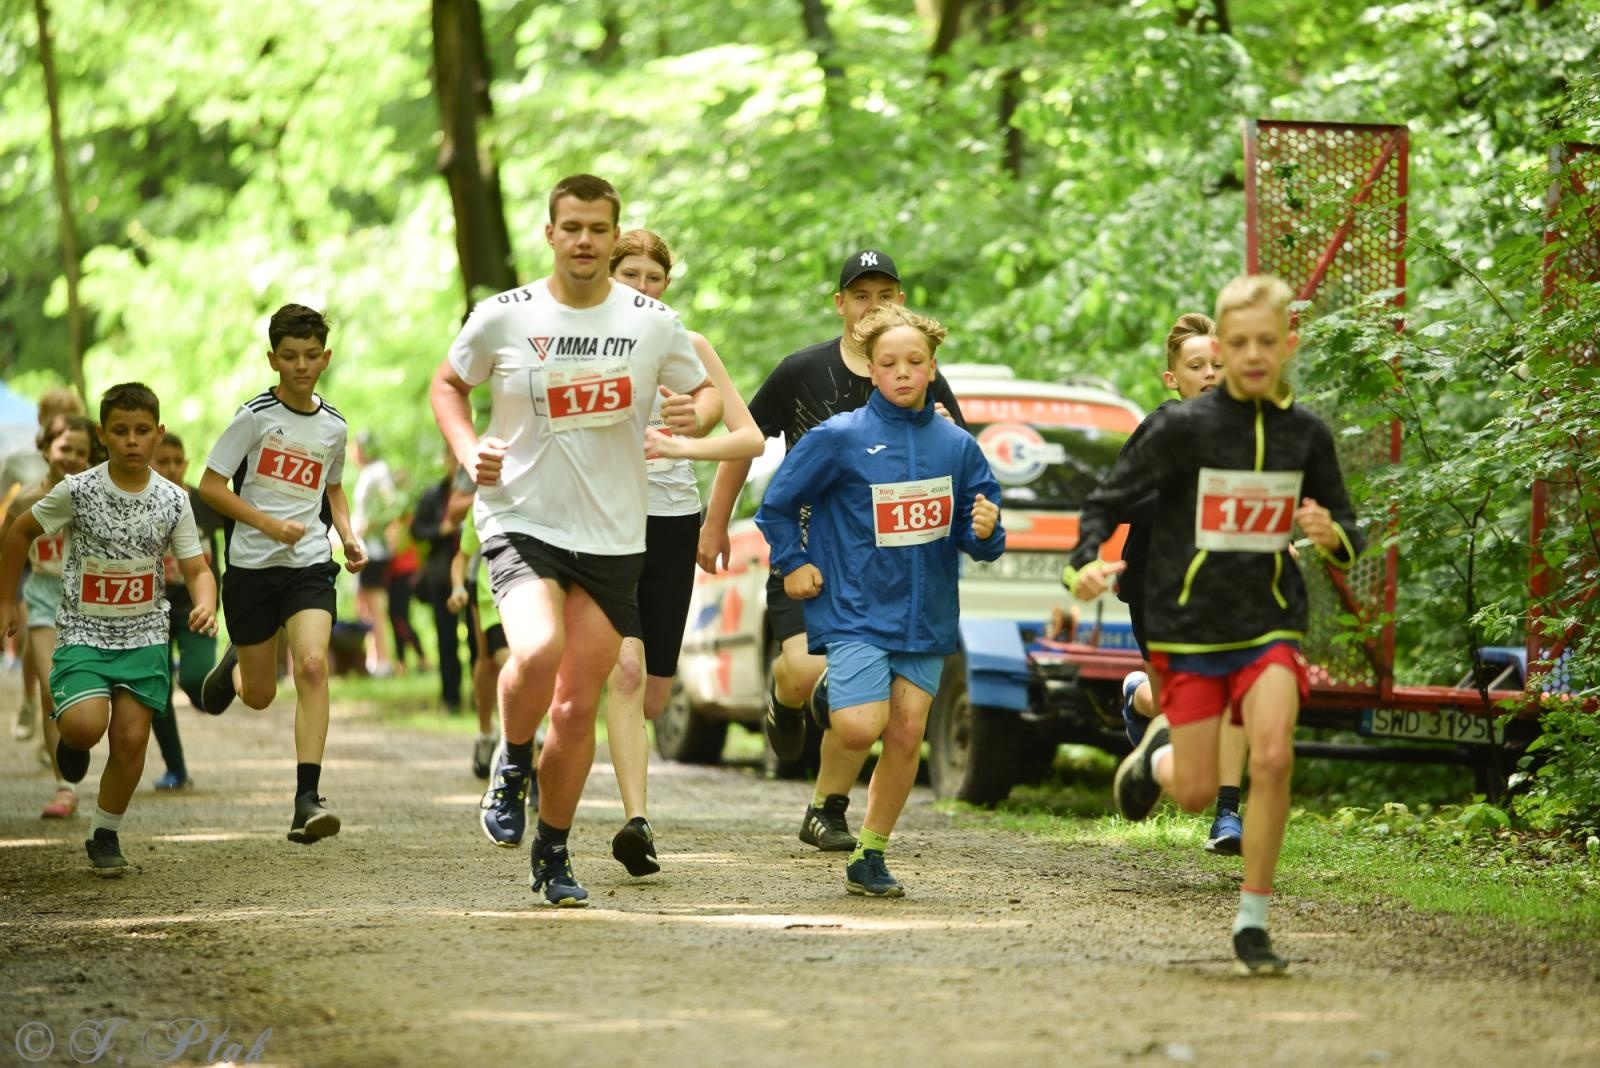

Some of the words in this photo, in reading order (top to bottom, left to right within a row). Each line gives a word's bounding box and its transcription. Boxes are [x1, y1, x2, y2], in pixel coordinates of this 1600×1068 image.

[860, 251, 879, 267] NY
[556, 337, 598, 356] MMA
[602, 337, 638, 357] CITY
[563, 381, 621, 414] 175
[271, 455, 314, 485] 176
[891, 500, 942, 531] 183
[1219, 498, 1286, 533] 177
[95, 578, 145, 603] 178
[1375, 709, 1420, 734] SWD
[1427, 711, 1493, 739] 3195
